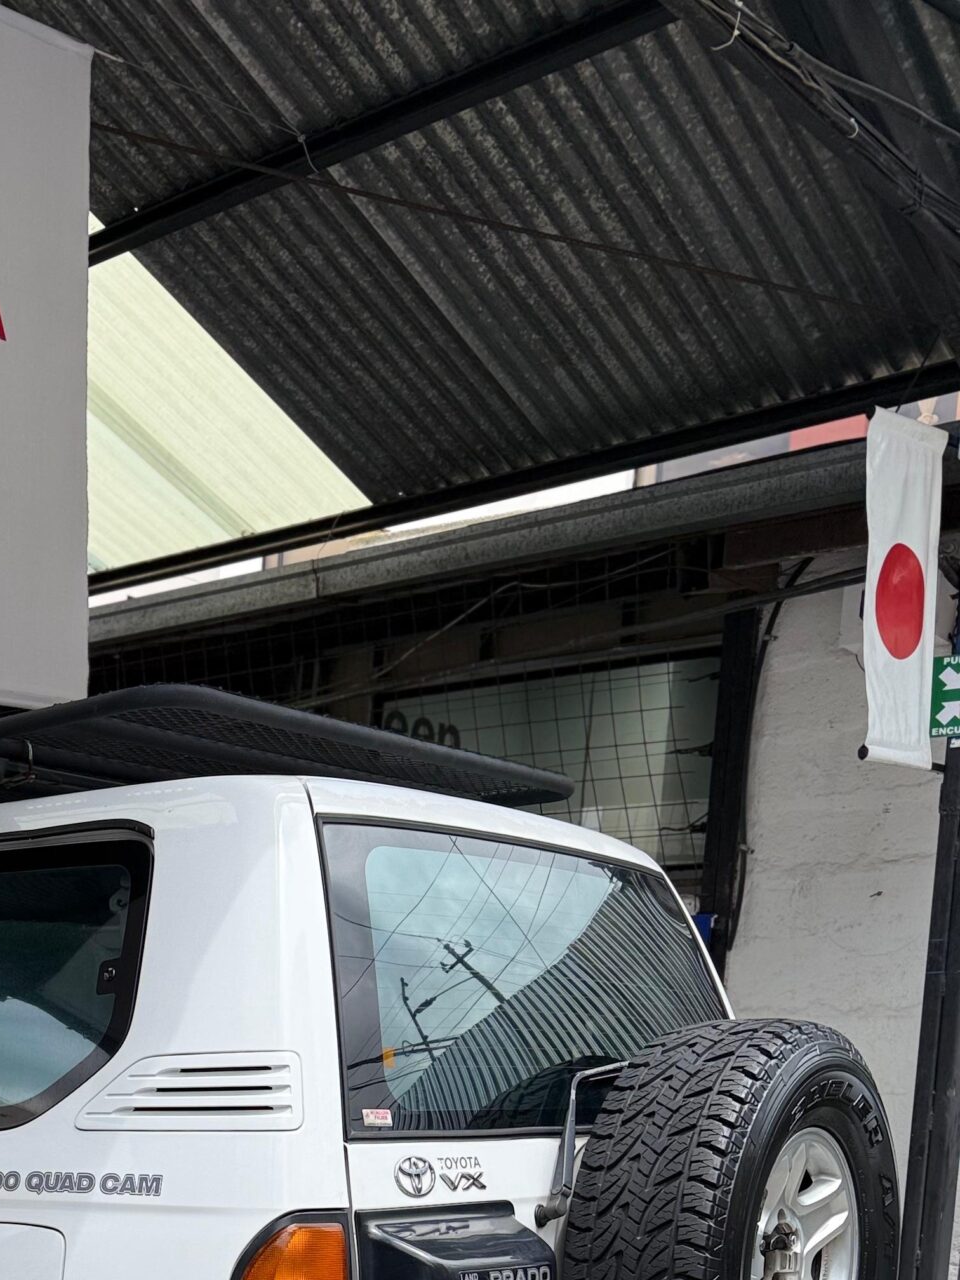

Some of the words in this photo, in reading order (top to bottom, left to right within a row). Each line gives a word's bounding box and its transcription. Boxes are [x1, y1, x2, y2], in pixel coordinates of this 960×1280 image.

[943, 656, 960, 666] PU
[437, 1156, 481, 1170] TOYOTA
[25, 1171, 96, 1195] QUAD
[99, 1172, 164, 1197] CAM
[439, 1171, 487, 1192] VX
